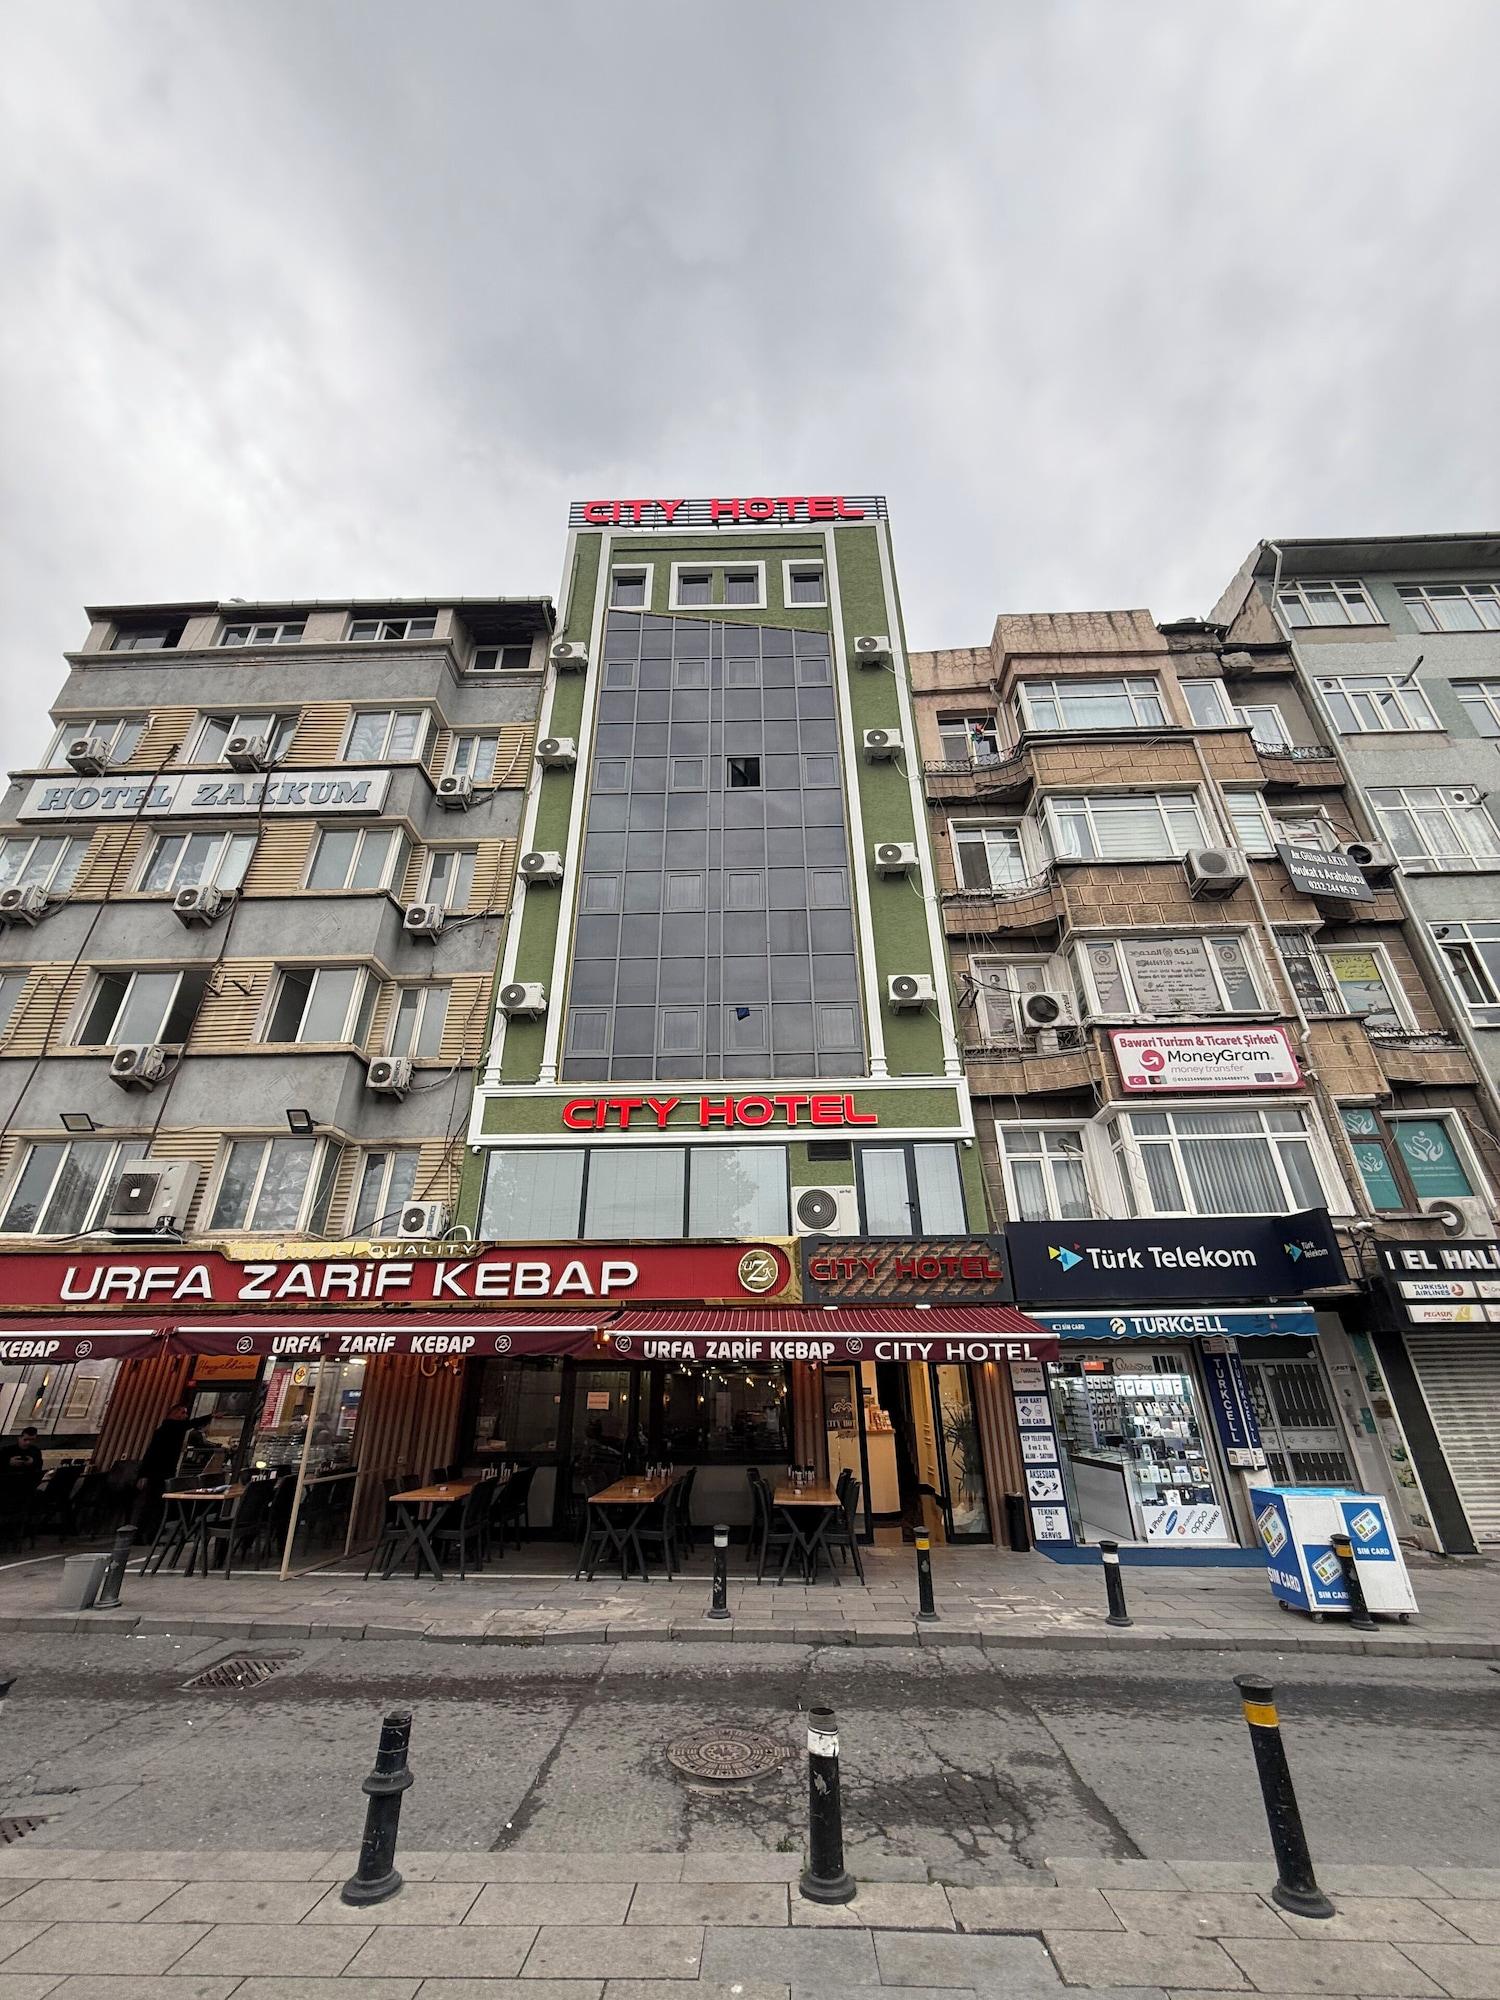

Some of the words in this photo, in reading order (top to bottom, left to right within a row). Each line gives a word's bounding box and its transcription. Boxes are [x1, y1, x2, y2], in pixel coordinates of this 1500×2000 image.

[583, 498, 686, 523] CITY
[710, 496, 865, 521] HOTEL
[37, 783, 173, 812] HOTEL
[191, 780, 374, 808] ZAKKUM
[1119, 1036, 1156, 1049] Bawari
[1156, 1036, 1194, 1048] Turizm
[1195, 1036, 1205, 1047] &
[1204, 1034, 1242, 1047] Ticaret
[1243, 1033, 1279, 1048] Şirketi
[1167, 1049, 1270, 1065] MoneyGram
[1170, 1065, 1204, 1075] money
[1205, 1064, 1245, 1073] transfer
[562, 1096, 681, 1130] CITY
[699, 1093, 878, 1128] HOTEL
[371, 1243, 477, 1257] QUALITY
[1301, 1241, 1315, 1250] Türk
[1303, 1248, 1329, 1259] Telekom
[1086, 1247, 1144, 1269] Türk
[1147, 1246, 1257, 1269] Telekom
[1400, 1249, 1438, 1270] EL
[808, 1257, 881, 1282] CITY
[896, 1256, 1003, 1280] HOTEL
[60, 1264, 213, 1301] URFA
[431, 1259, 640, 1299] KEBAP
[1130, 1316, 1229, 1334] TURKCELL
[0, 1340, 60, 1358] KEBAP
[271, 1335, 322, 1353] URFA
[410, 1335, 476, 1353] KEBAP
[643, 1340, 696, 1359] URFA
[769, 1341, 835, 1360] KEBAP
[874, 1341, 934, 1360] CITY
[945, 1343, 1038, 1361] HOTEL
[1213, 1358, 1241, 1443] TURKCELL
[1231, 1358, 1258, 1443] TURKCELL
[1029, 1470, 1056, 1479] AKSESUAR
[1152, 1510, 1167, 1530] iPhone
[1202, 1510, 1220, 1535] HUAWEI
[1356, 1547, 1371, 1556] SIM
[1370, 1547, 1391, 1556] CARD
[1267, 1566, 1282, 1585] SIM
[1280, 1571, 1302, 1593] CARD
[1318, 1591, 1331, 1600] SIM
[1331, 1591, 1349, 1600] CAR
